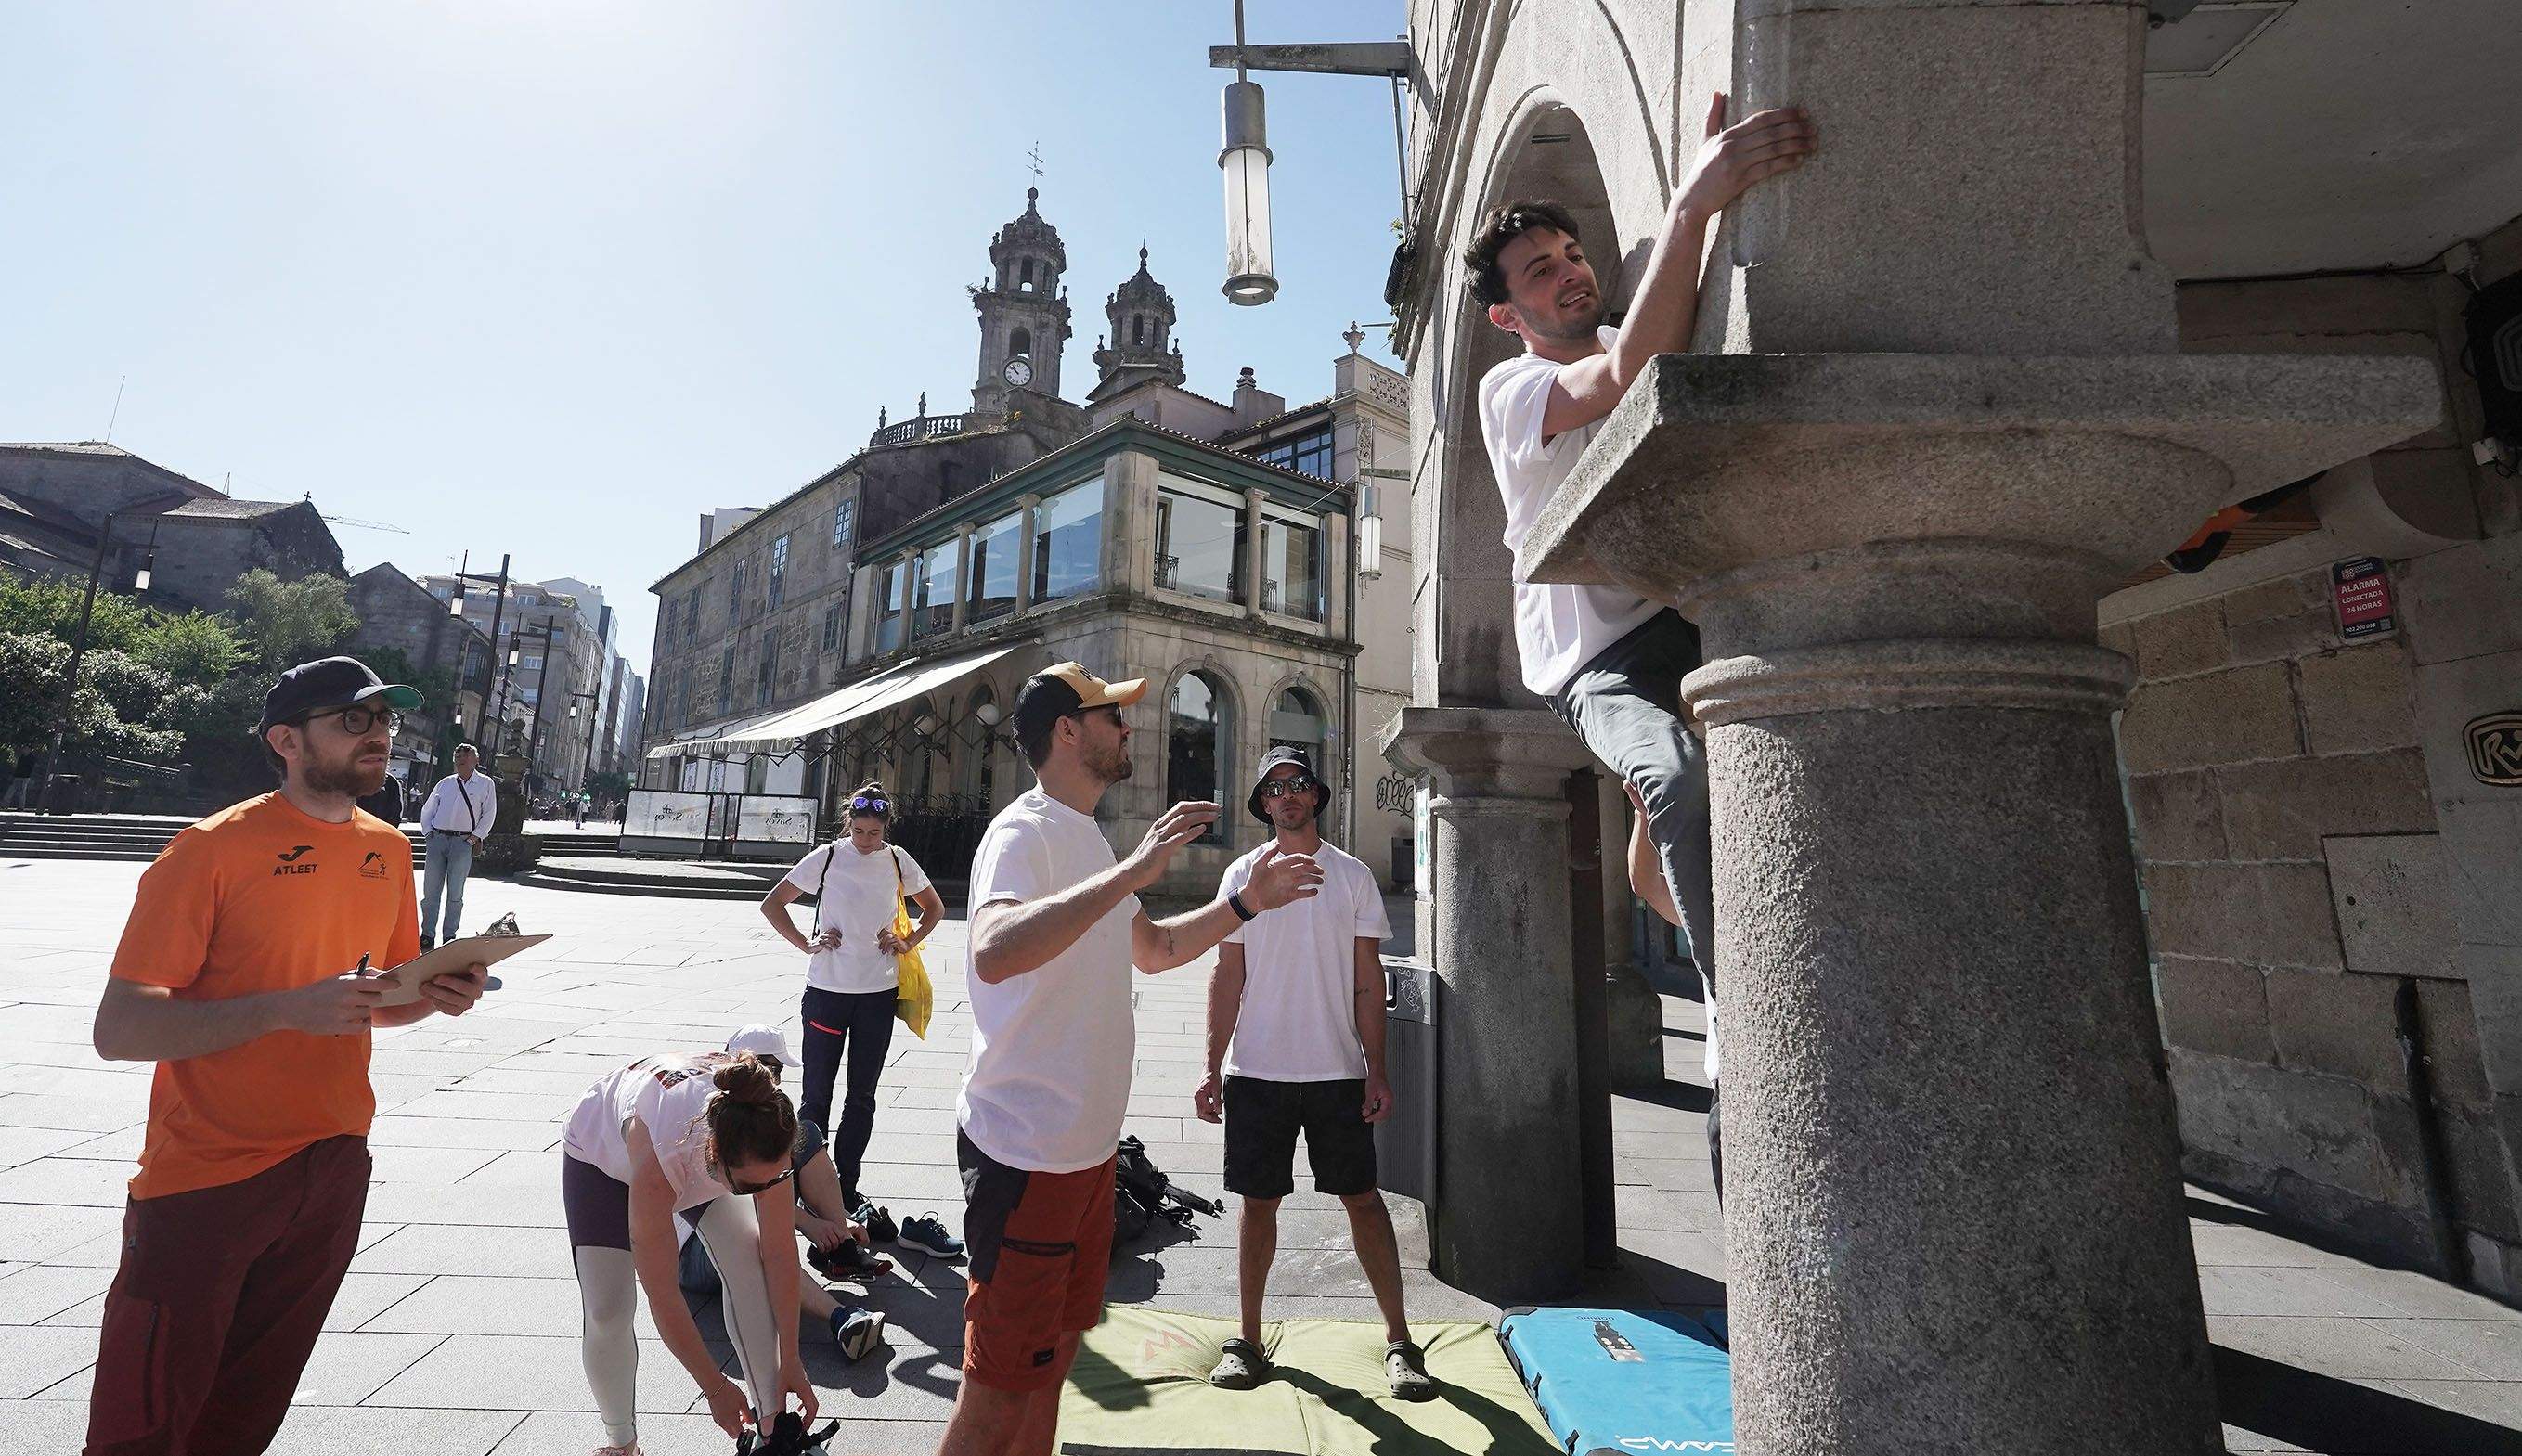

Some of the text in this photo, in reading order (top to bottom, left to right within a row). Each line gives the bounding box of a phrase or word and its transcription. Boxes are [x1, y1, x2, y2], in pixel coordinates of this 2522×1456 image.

[2341, 578, 2381, 594] ALARMA
[2342, 590, 2384, 604] CONECTADA
[2357, 600, 2383, 612] HORAS
[274, 864, 317, 876] ATLEET
